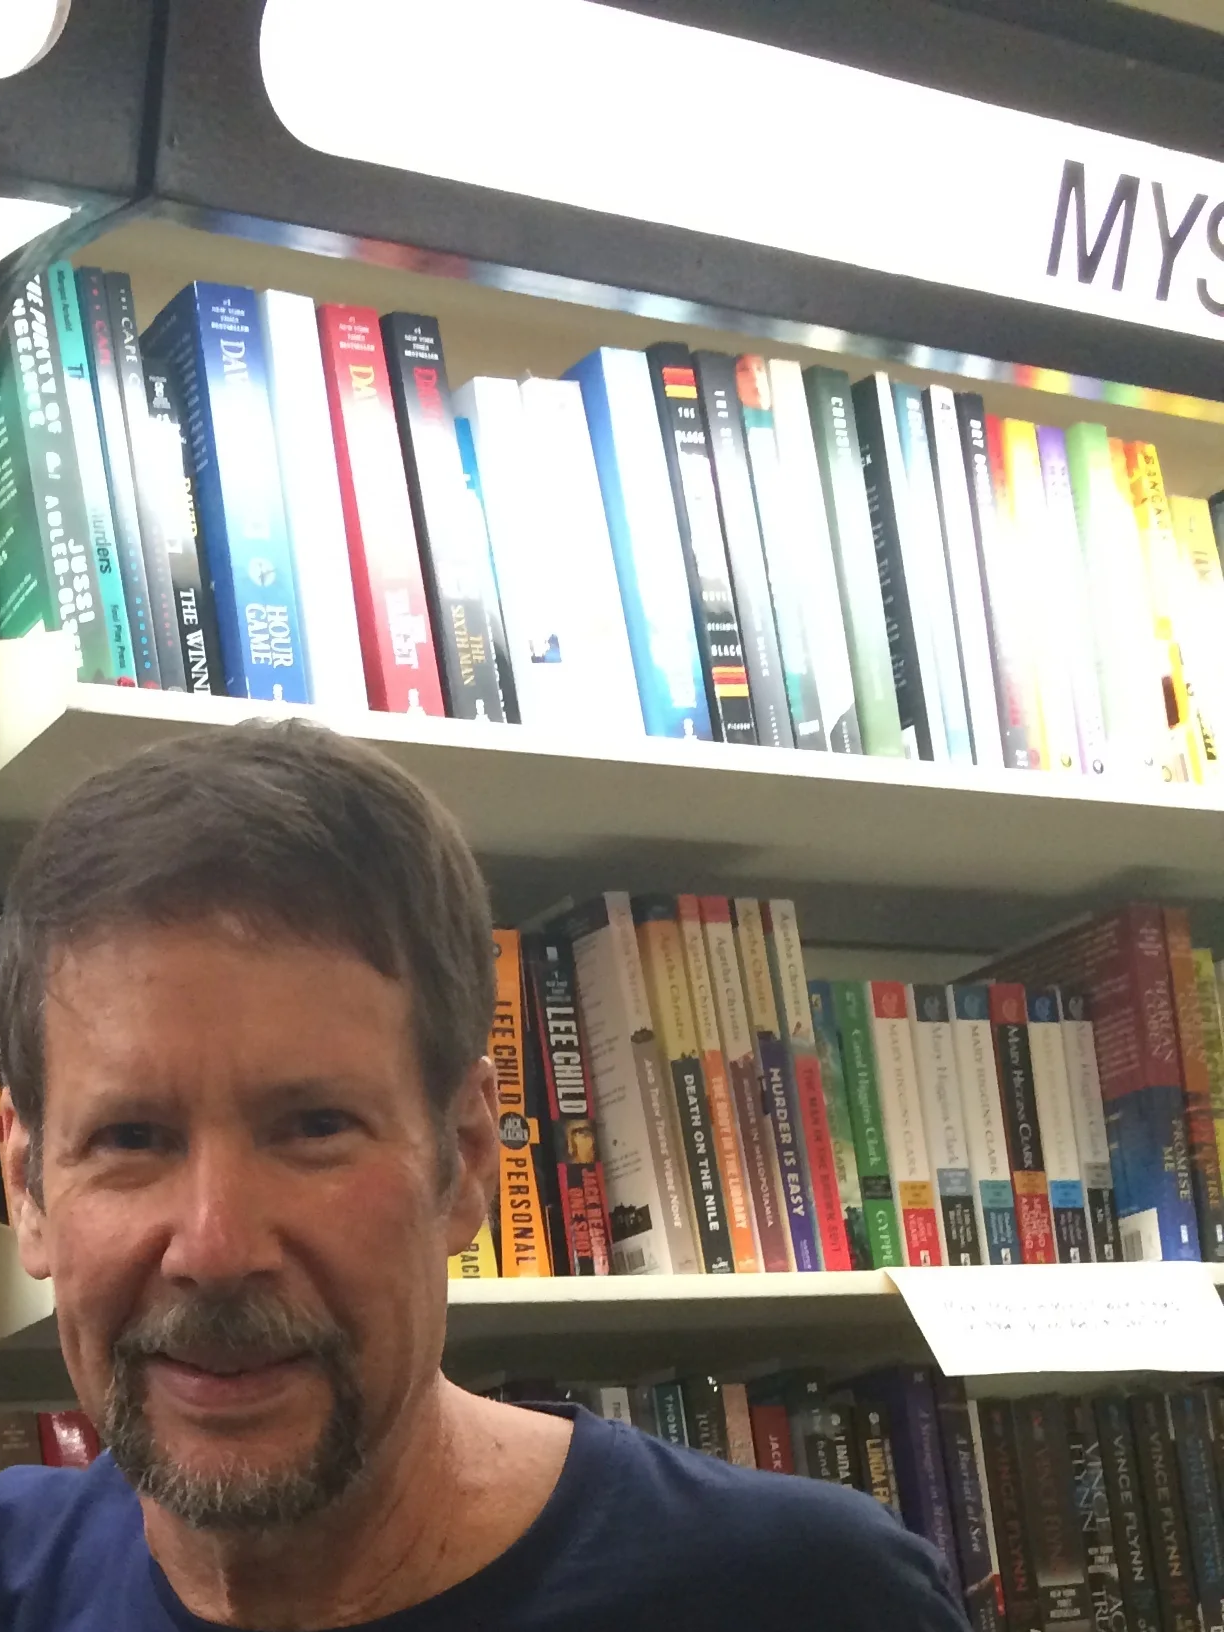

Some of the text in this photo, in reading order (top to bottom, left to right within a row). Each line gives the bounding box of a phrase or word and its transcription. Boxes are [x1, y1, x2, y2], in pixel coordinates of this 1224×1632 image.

[245, 603, 273, 665] GAME
[266, 604, 294, 669] HOUR
[491, 1001, 522, 1106] LEE CHILD
[545, 1006, 588, 1114] LEE CHILD
[683, 1073, 719, 1231] DEATH ON THE NILE
[769, 1067, 805, 1217] MURDER IS EASY
[505, 1157, 537, 1266] PERSONAL
[769, 1434, 783, 1470] JACK
[835, 1434, 852, 1480] LINDA
[866, 1438, 887, 1484] LINDA
[1149, 1432, 1183, 1577] VINCE FLYNN
[1113, 1434, 1145, 1582] VINCE FLYNN
